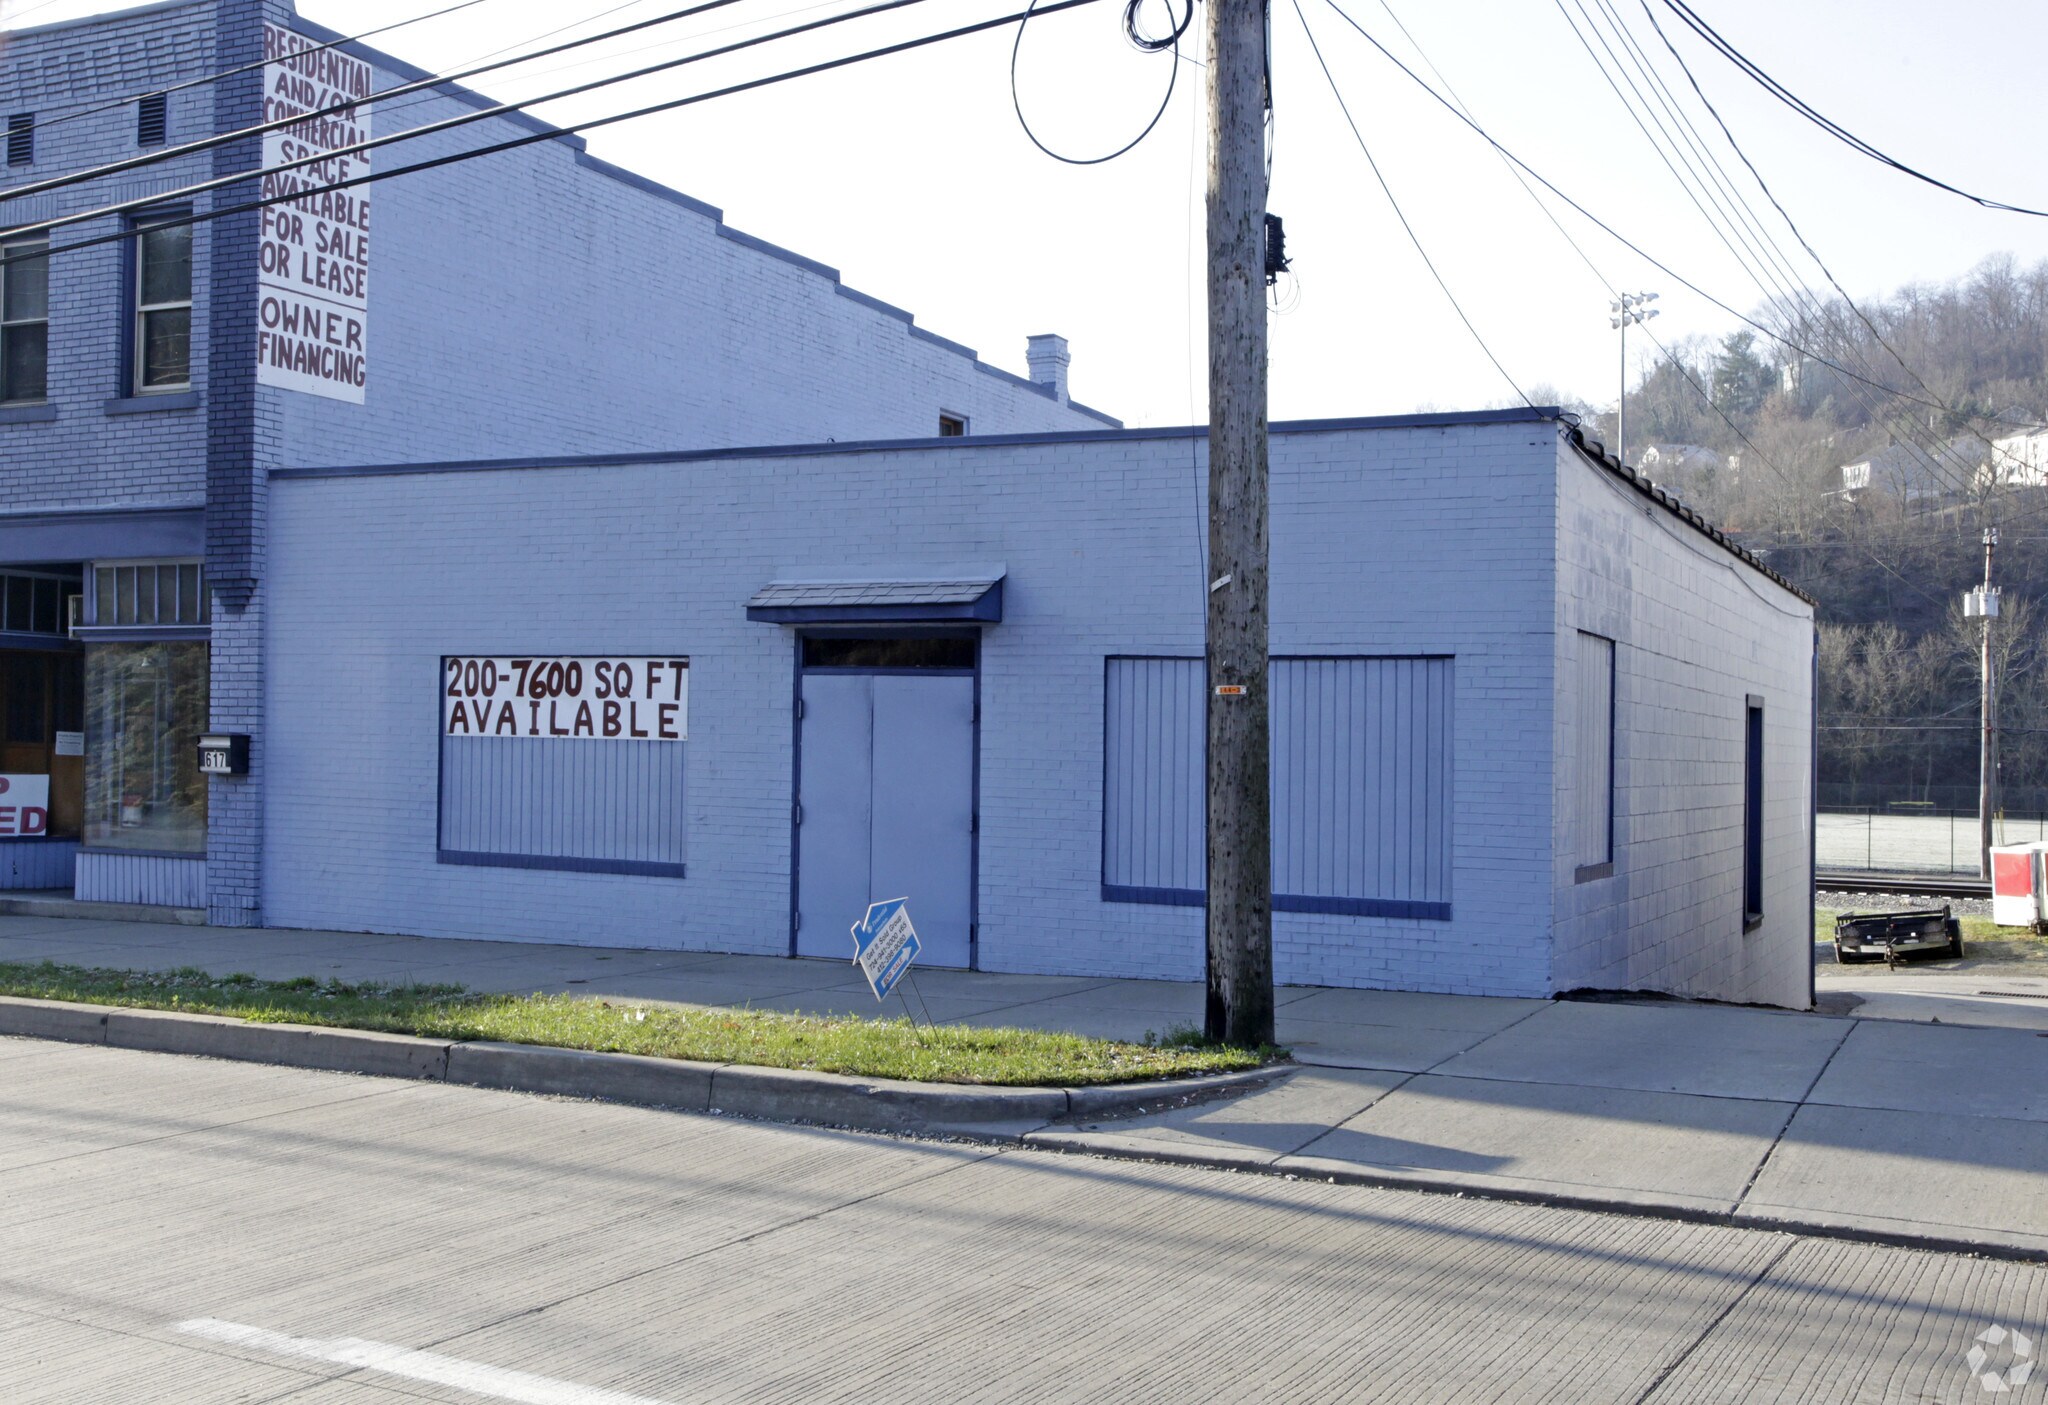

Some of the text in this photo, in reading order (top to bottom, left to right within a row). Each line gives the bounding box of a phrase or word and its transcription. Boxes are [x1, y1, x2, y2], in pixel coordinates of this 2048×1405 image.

[275, 72, 357, 124] AND/OR
[280, 140, 351, 190] SPACE
[262, 171, 370, 232] AVAILABLE
[261, 205, 368, 266] FOR SALE
[260, 241, 367, 299] OR LEASE
[261, 297, 362, 352] OWNER
[258, 331, 366, 387] FINANCING
[447, 658, 583, 699] 200-7600
[595, 661, 634, 699] SQ
[450, 699, 680, 739] AVAILABLE
[205, 752, 225, 767] 617
[879, 930, 890, 944] Sold
[889, 915, 902, 931] Group
